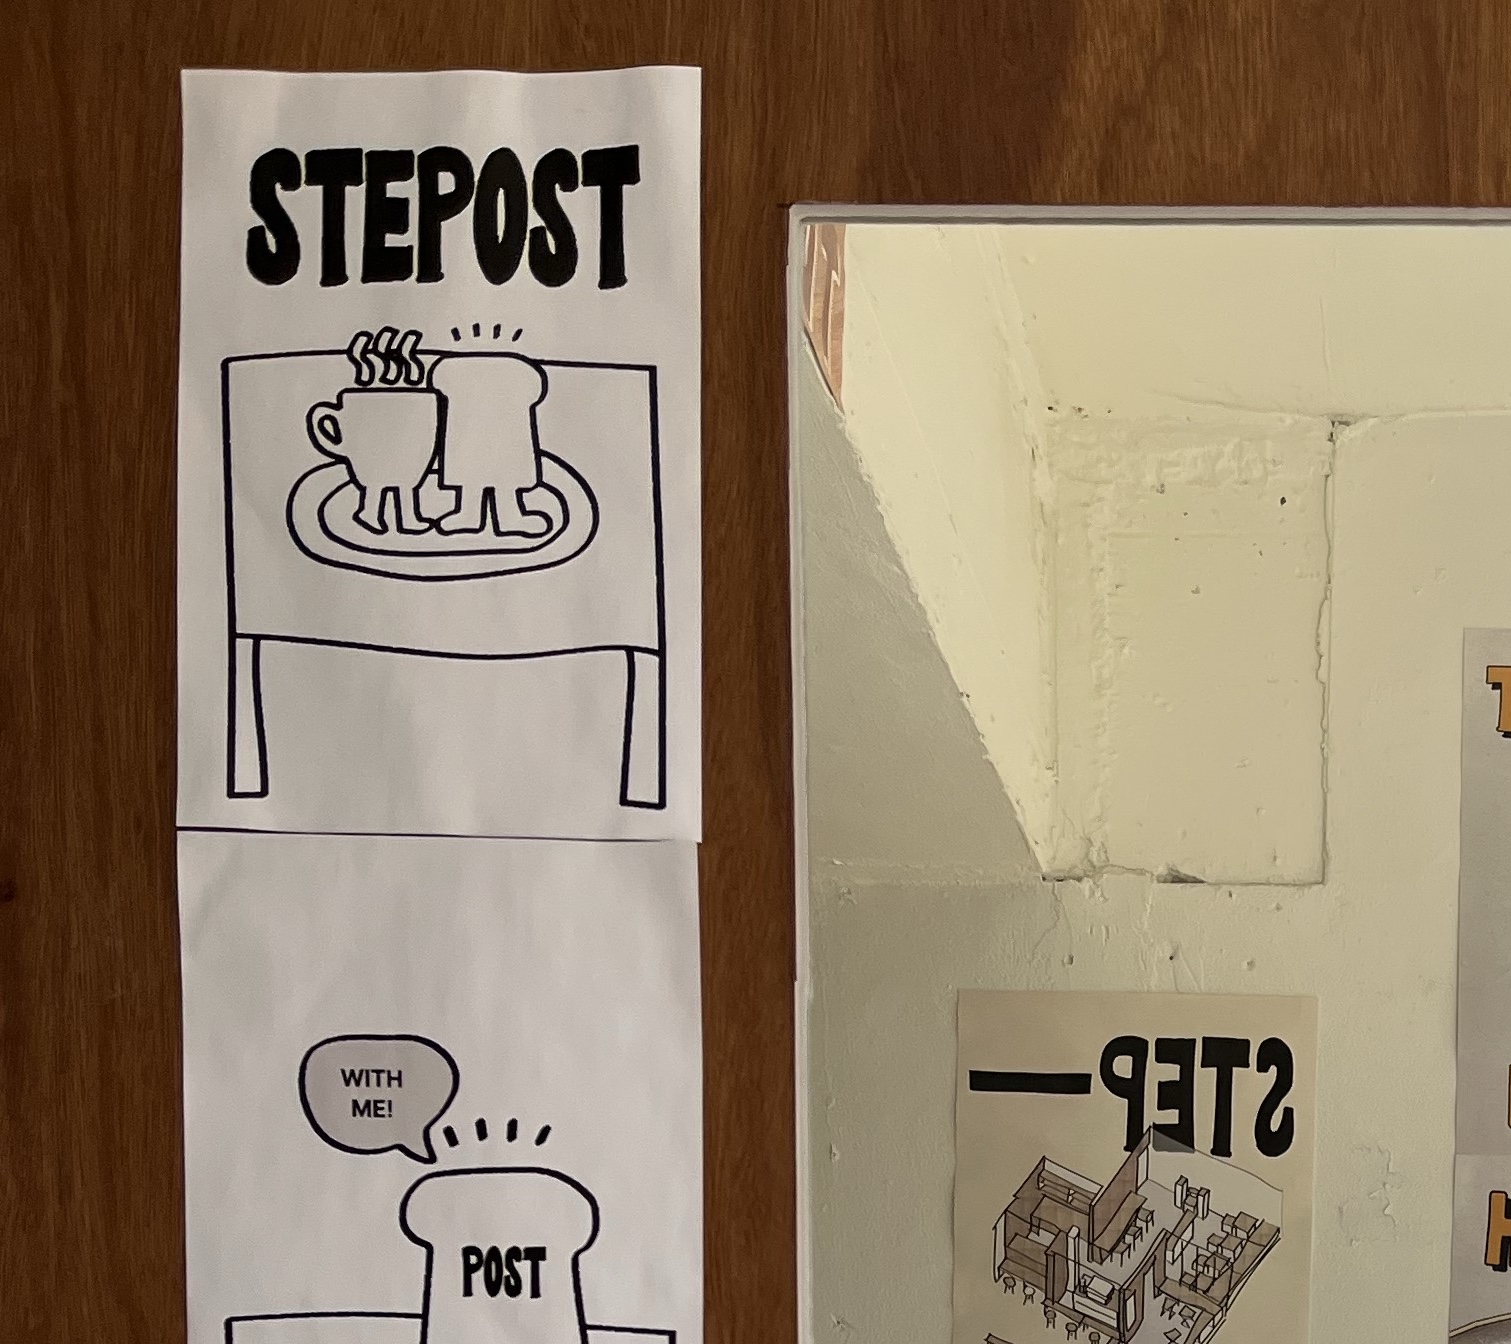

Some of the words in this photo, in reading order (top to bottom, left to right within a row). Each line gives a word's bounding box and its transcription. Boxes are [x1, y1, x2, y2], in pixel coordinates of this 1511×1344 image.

[246, 144, 641, 290] STEPOST
[340, 1068, 403, 1089] WITH
[351, 1098, 393, 1119] ME!
[461, 1245, 548, 1299] POST
